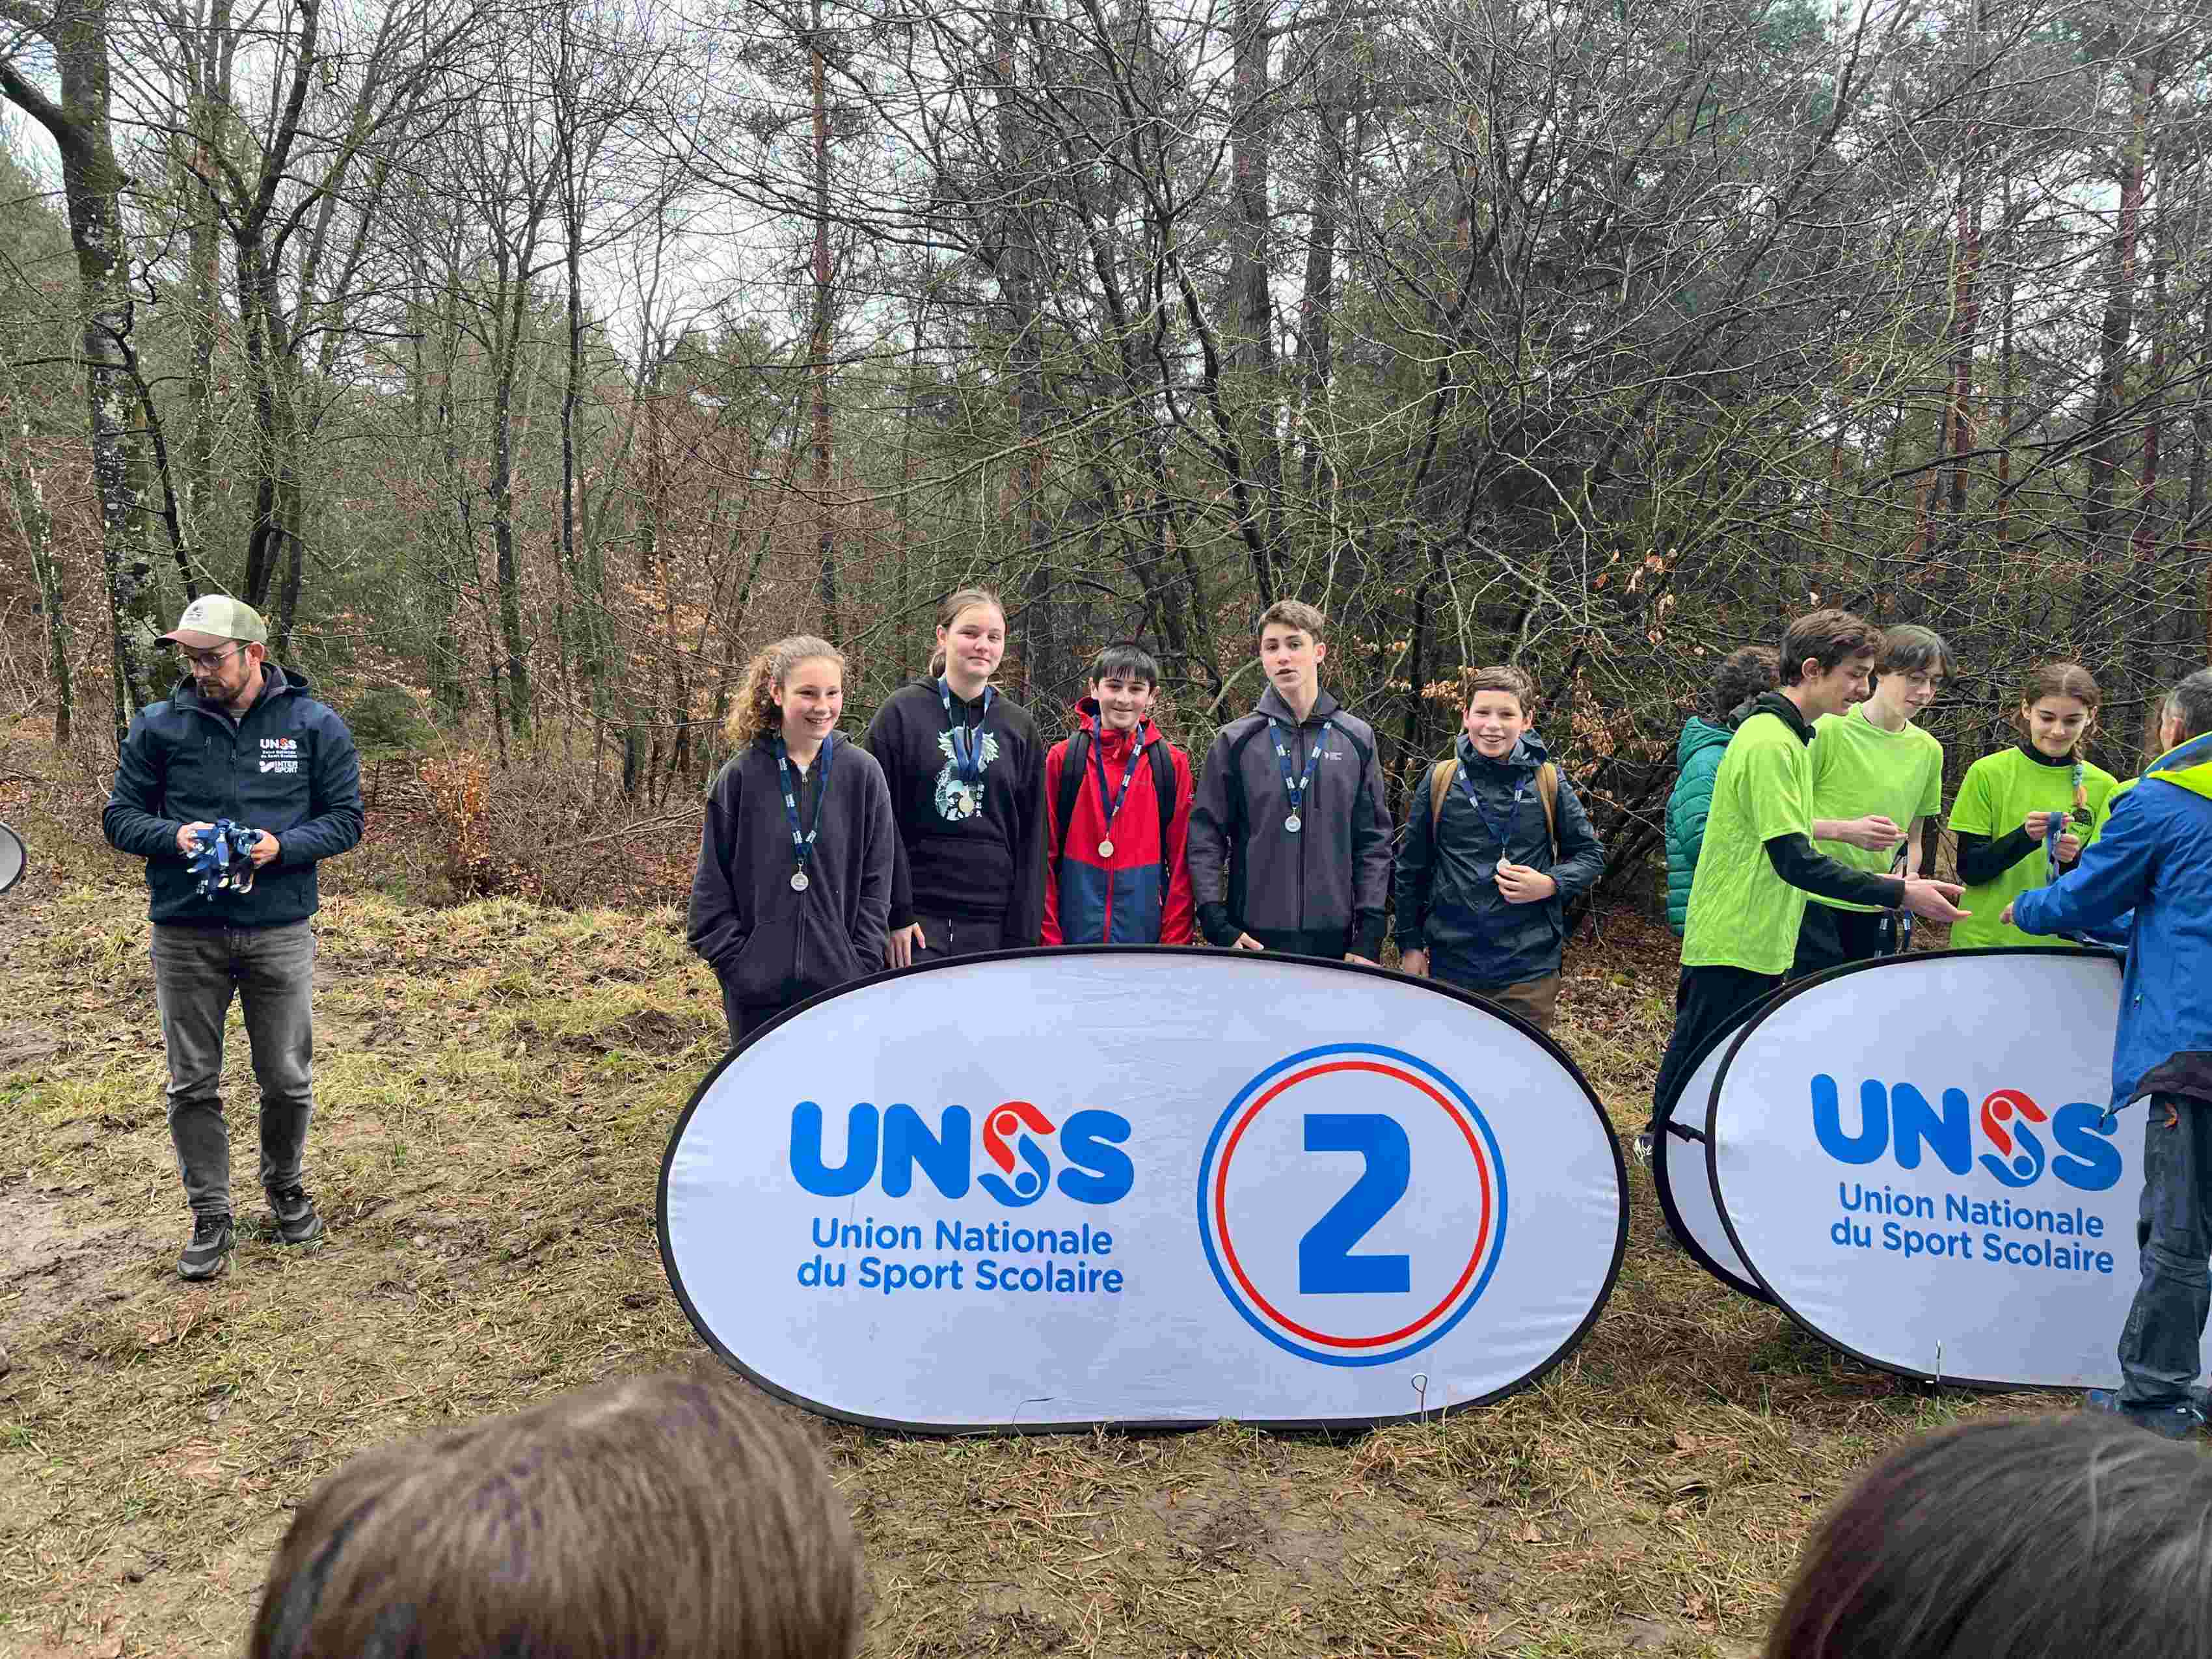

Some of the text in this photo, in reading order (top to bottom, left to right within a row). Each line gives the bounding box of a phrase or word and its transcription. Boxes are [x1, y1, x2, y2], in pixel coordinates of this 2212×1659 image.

[260, 738, 297, 749] UNSS
[790, 1101, 1135, 1208] UNSS
[1811, 1073, 2123, 1192] UNSS
[1299, 1113, 1411, 1295] 2
[1839, 1183, 2103, 1239] Union Nationale
[812, 1217, 1113, 1256] Union Nationale
[1831, 1217, 2114, 1274] du Sport Scolaire
[797, 1254, 1125, 1295] du Sport Scolaire
